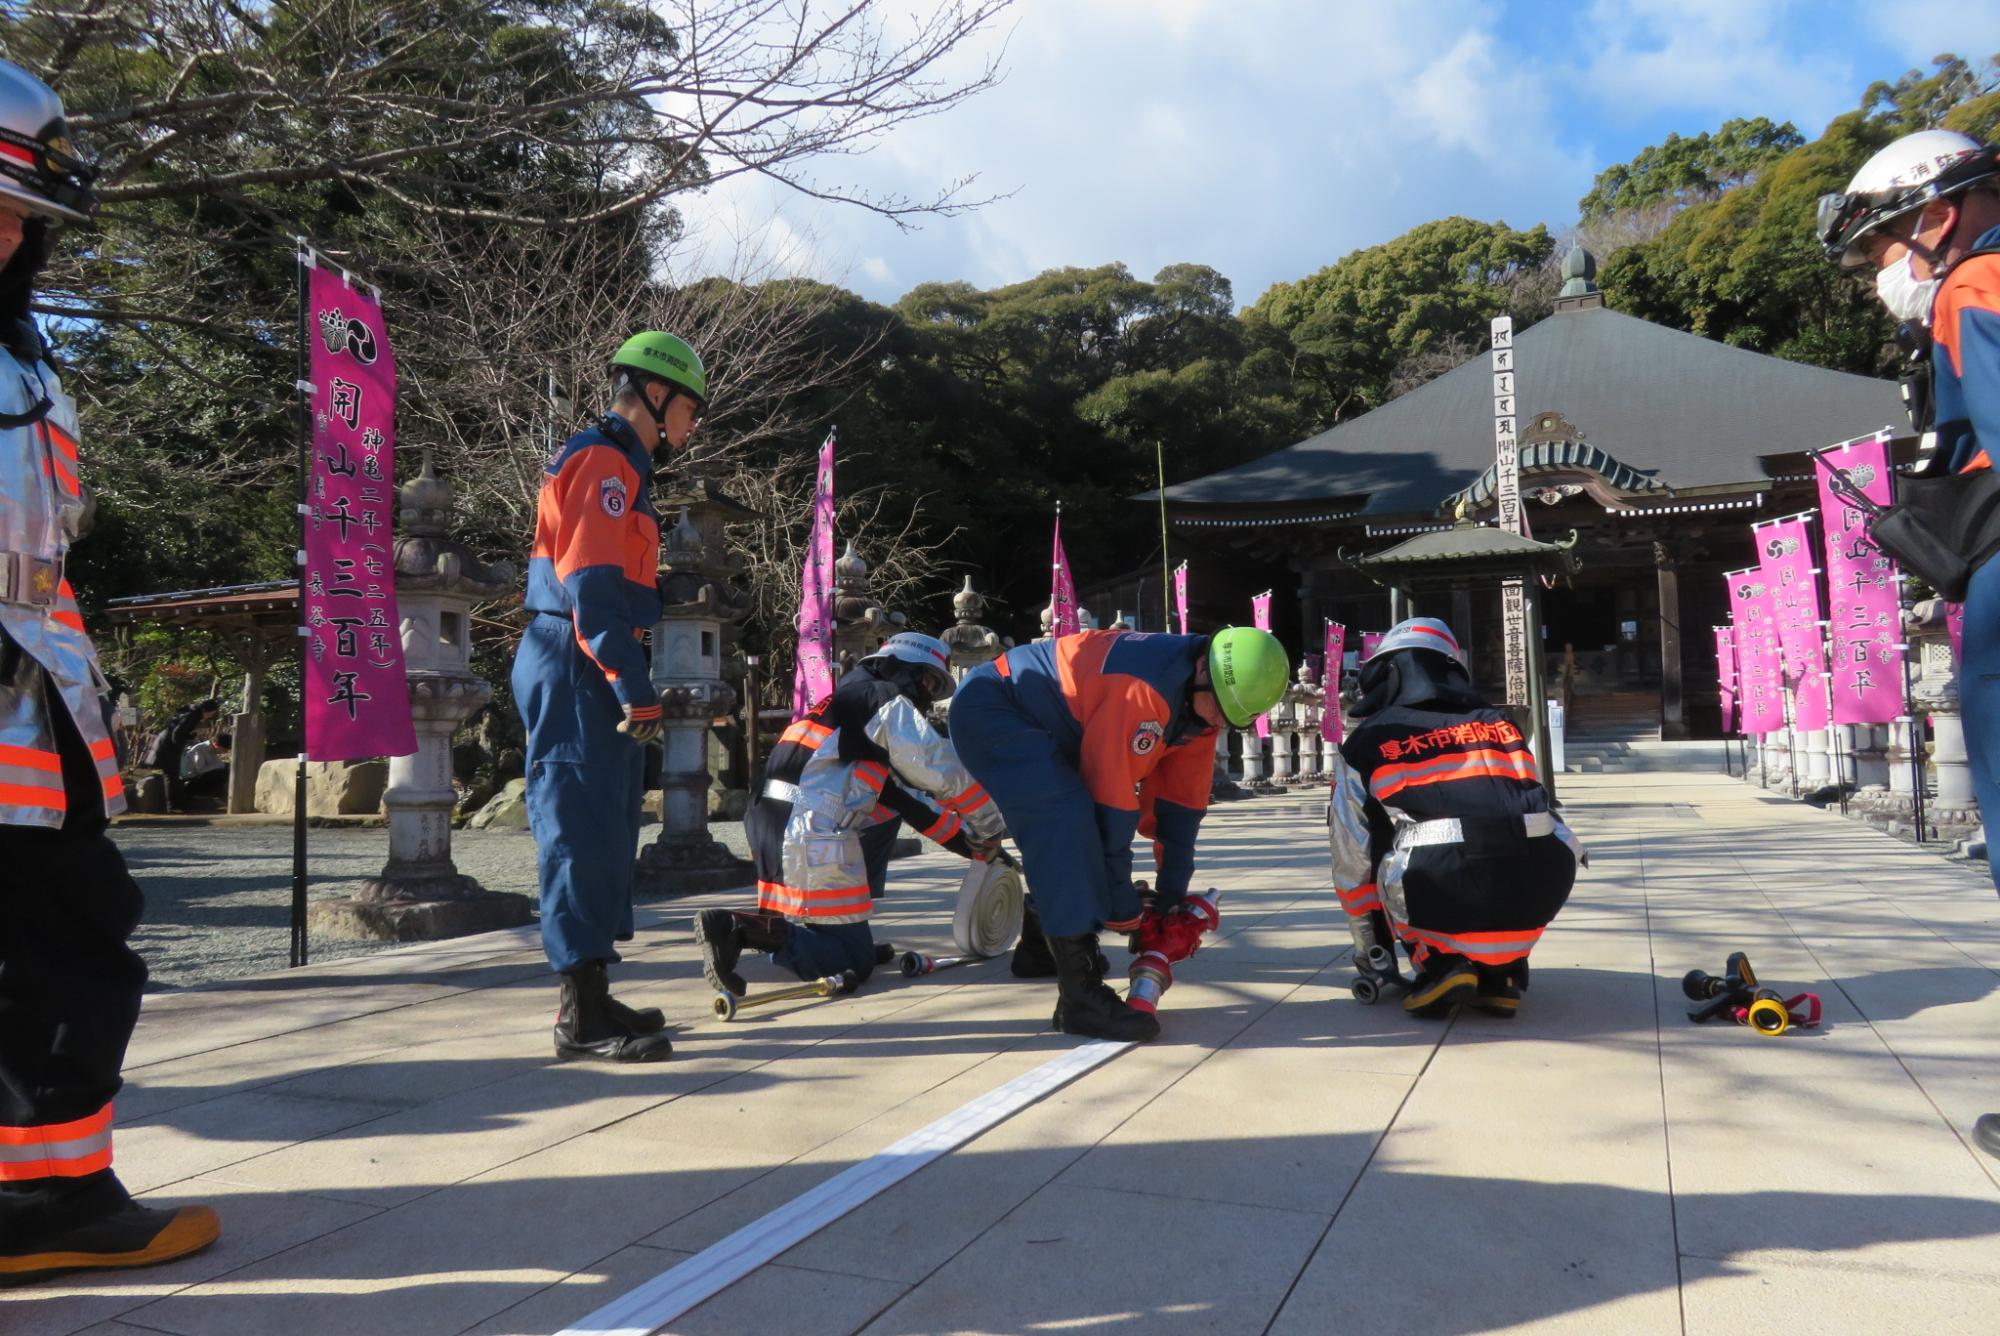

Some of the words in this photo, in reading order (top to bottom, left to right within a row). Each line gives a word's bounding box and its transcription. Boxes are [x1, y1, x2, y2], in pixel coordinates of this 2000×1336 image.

[611, 497, 620, 511] 5
[1498, 439, 1518, 533] 開山千三百年
[327, 377, 372, 720] 開山千三百年
[1378, 720, 1523, 760] 厚木市消防団
